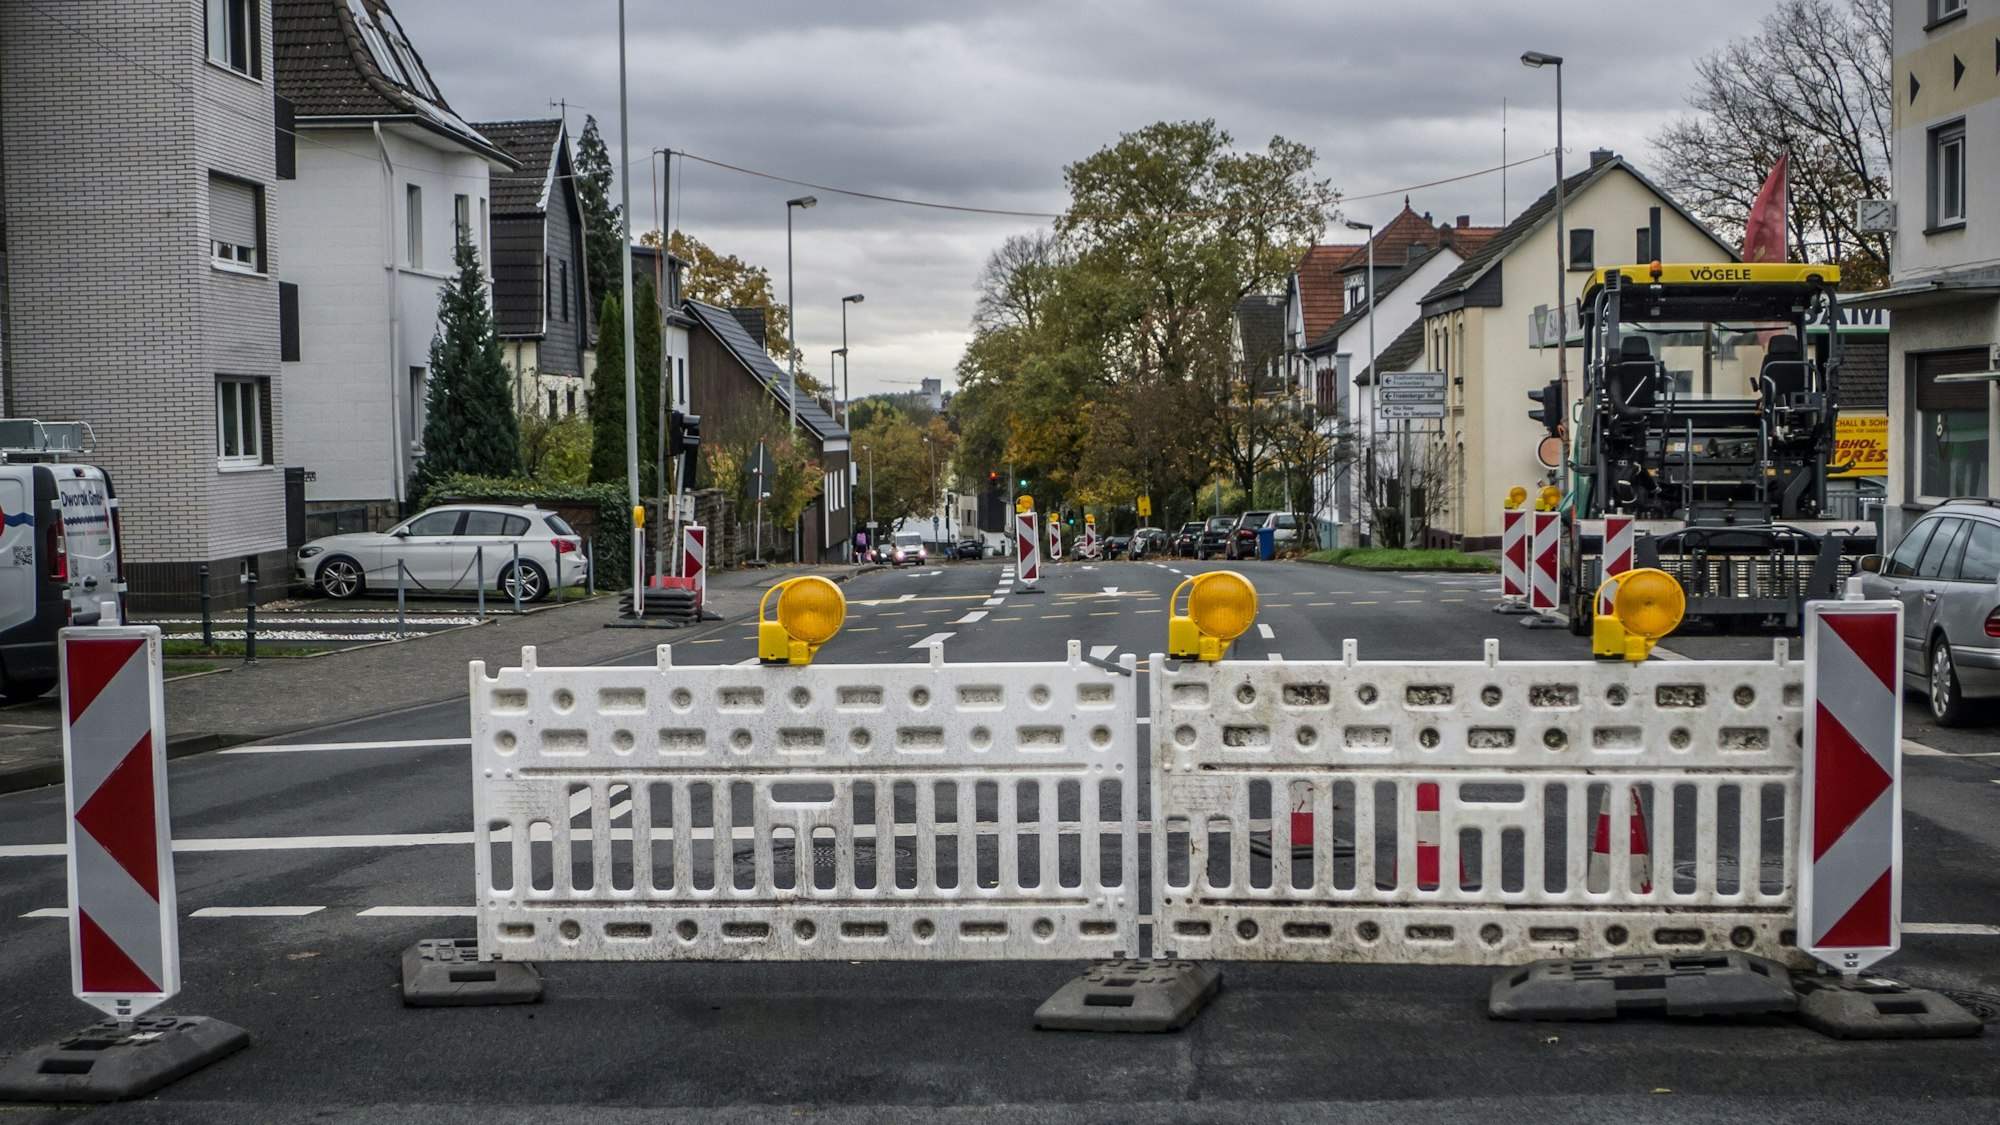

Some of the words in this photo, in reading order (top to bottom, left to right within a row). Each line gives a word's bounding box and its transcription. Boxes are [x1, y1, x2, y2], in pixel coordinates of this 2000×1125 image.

[1690, 266, 1751, 280] VÖGELE
[1861, 419, 1866, 427] &
[61, 490, 89, 507] Dworak
